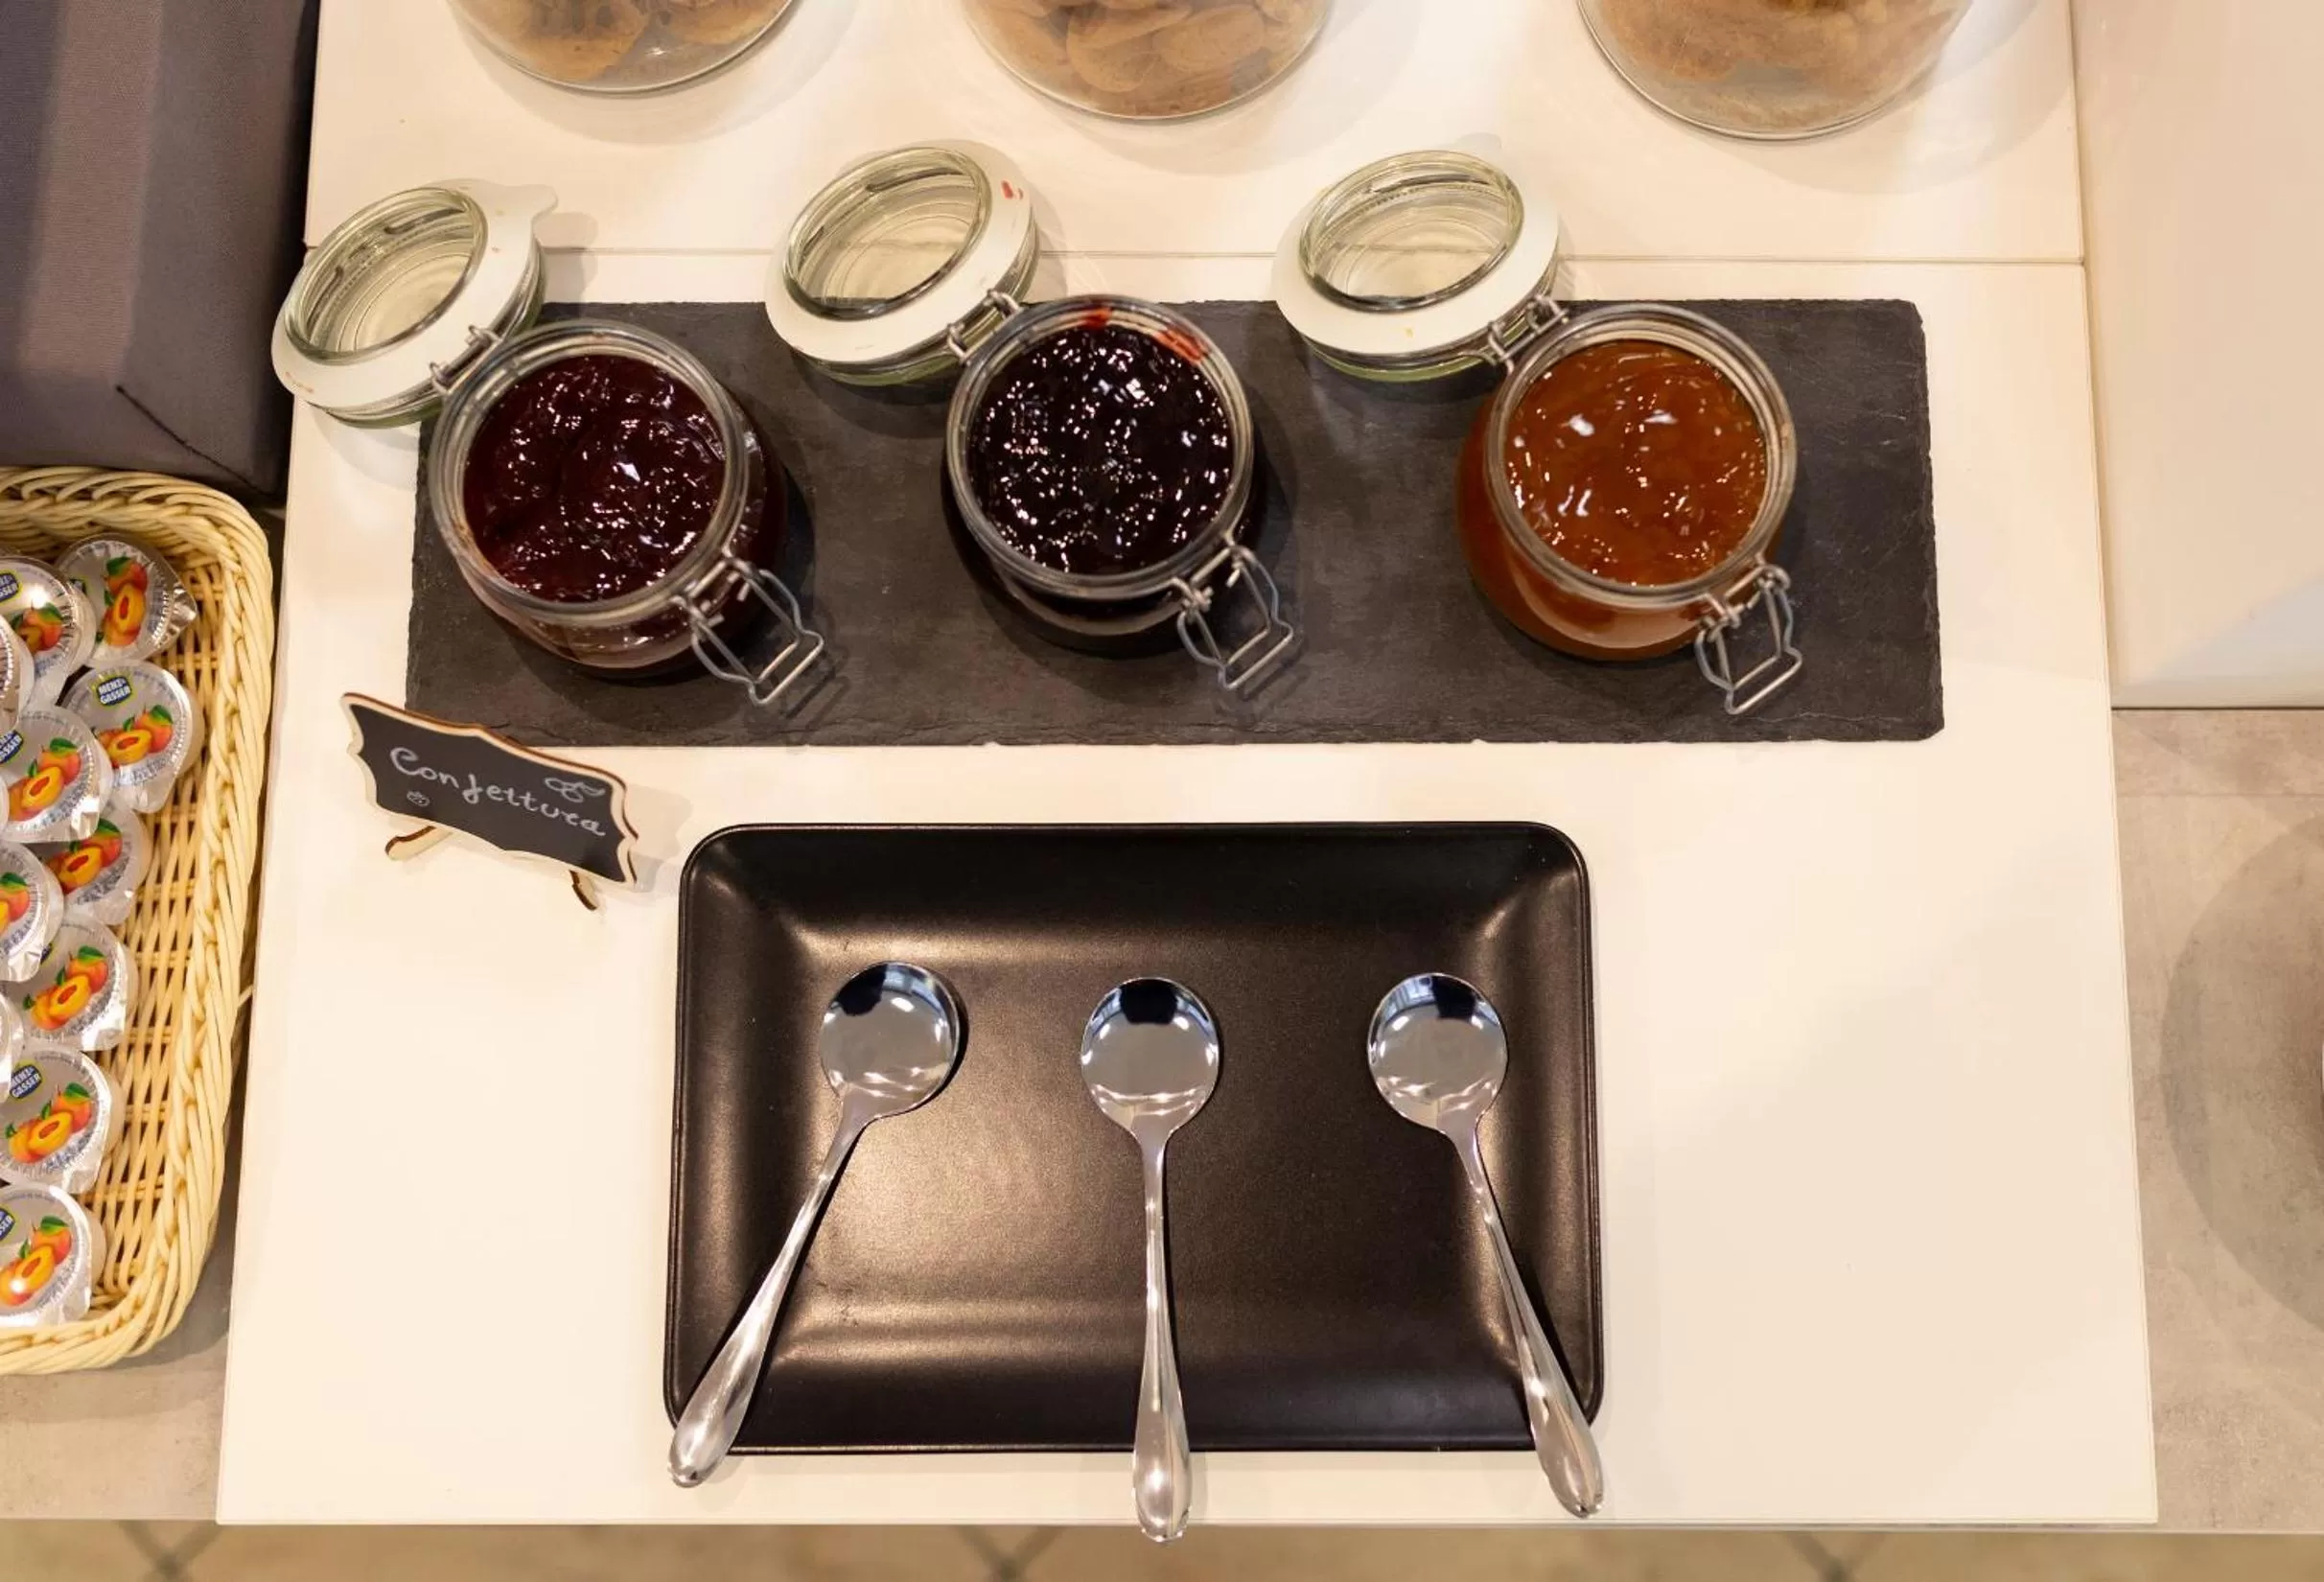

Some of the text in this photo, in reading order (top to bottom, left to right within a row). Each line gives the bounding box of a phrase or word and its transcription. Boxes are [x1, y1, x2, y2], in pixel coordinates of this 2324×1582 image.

[101, 686, 131, 704] GASSER
[390, 746, 606, 836] Confettura
[12, 1073, 40, 1098] GASSER
